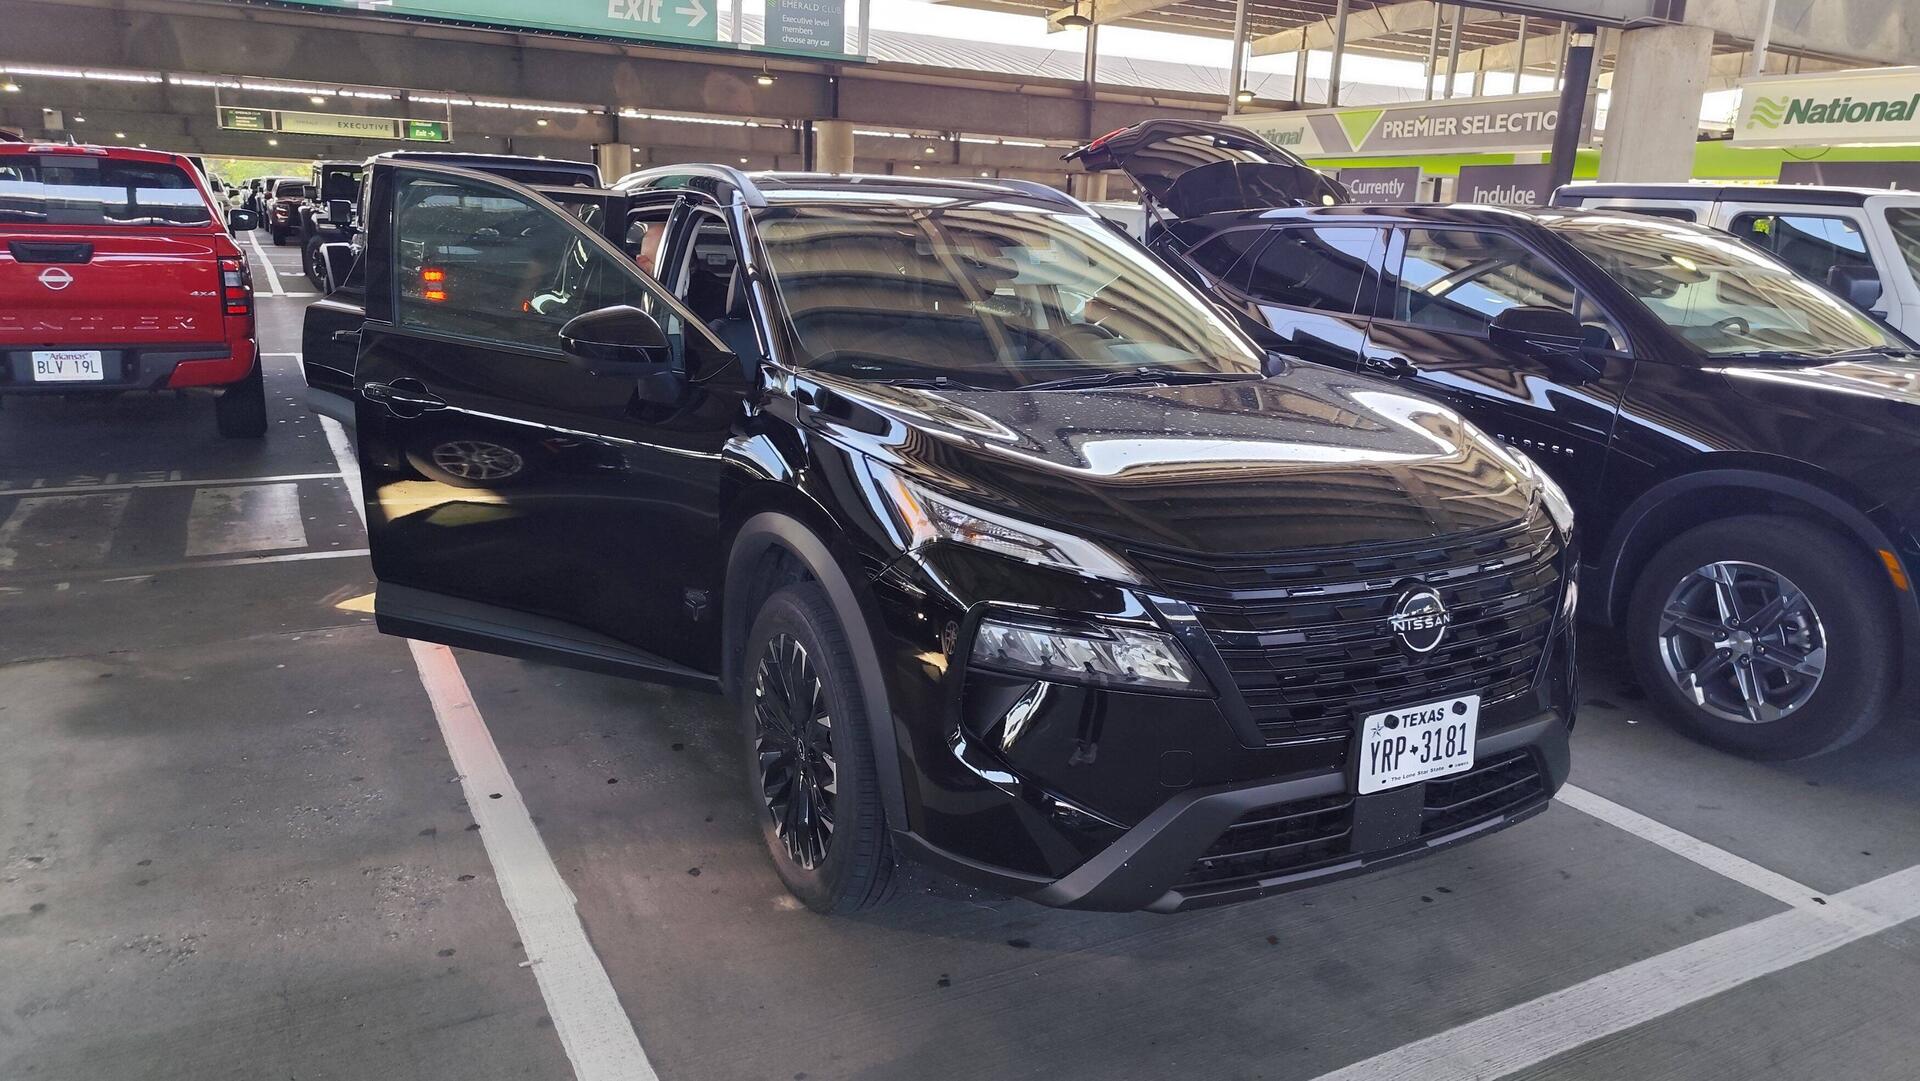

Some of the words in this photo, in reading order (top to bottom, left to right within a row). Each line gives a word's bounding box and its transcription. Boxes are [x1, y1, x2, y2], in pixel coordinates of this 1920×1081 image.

[607, 0, 662, 24] Exit
[782, 0, 819, 11] EMERALD
[822, 4, 841, 15] CLUB
[782, 14, 813, 26] Executive
[814, 18, 830, 27] level
[782, 26, 813, 36] members
[782, 34, 806, 45] choose
[806, 38, 819, 47] any
[1783, 93, 1920, 125] National
[337, 121, 389, 132] EXECUTIVE
[1382, 116, 1458, 139] PREMIER
[1461, 110, 1559, 135] SELECTIO
[1350, 178, 1405, 199] Currently
[1473, 184, 1537, 205] Indulge
[50, 352, 86, 361] Arkansas
[37, 360, 63, 374] BLV
[74, 360, 99, 374] 19L
[1391, 613, 1450, 632] NISSAN
[1402, 707, 1445, 728] TEXAS
[1370, 736, 1407, 775] YRP
[1420, 722, 1468, 763] 3181
